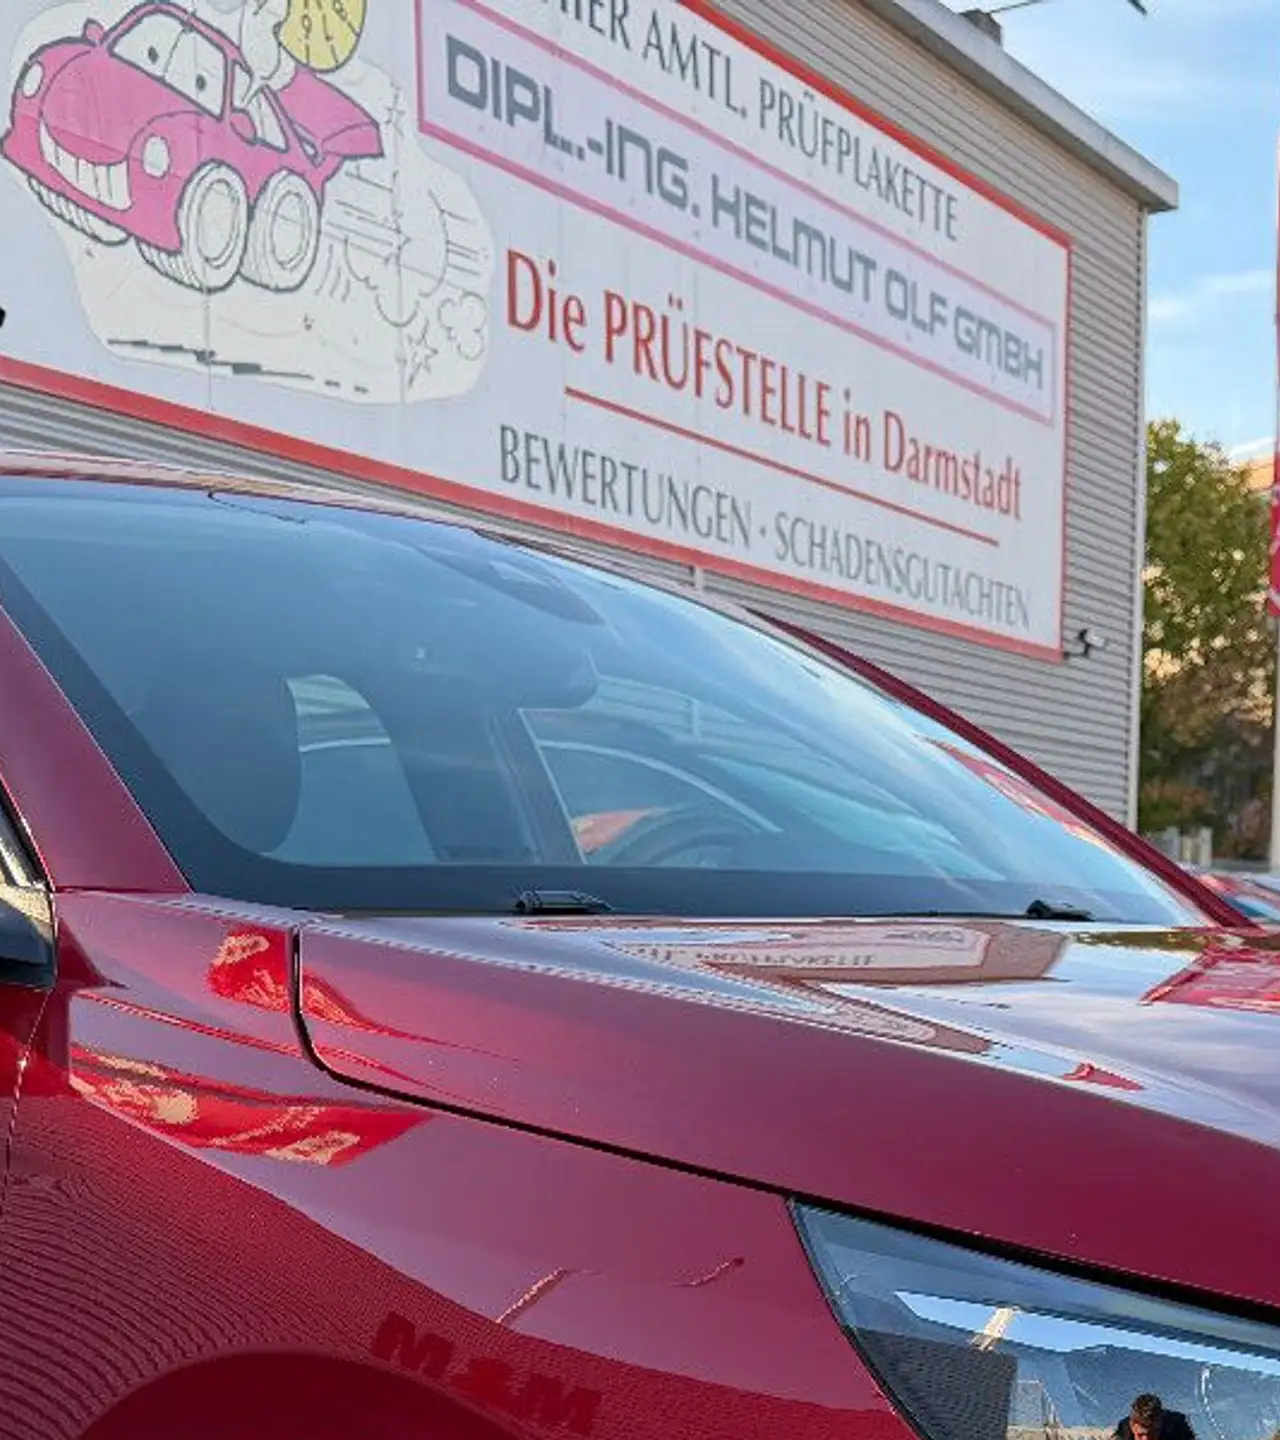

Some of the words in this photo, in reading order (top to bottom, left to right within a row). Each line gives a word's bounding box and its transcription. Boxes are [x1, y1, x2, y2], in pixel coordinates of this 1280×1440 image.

[445, 33, 702, 220] DIPL.-ING.
[710, 173, 878, 303] HELMUT
[884, 258, 950, 337] OLF
[642, 9, 749, 121] AMTL.
[758, 76, 961, 243] PRÜFPLAKETTE
[506, 246, 586, 353] Die
[602, 288, 833, 449] PRÜFSTELLE
[842, 387, 872, 464] in
[883, 409, 1023, 521] Darmstadt
[499, 423, 753, 552] BEWERTUNGEN
[773, 510, 1034, 634] SCHADENSGUTACHTEN
